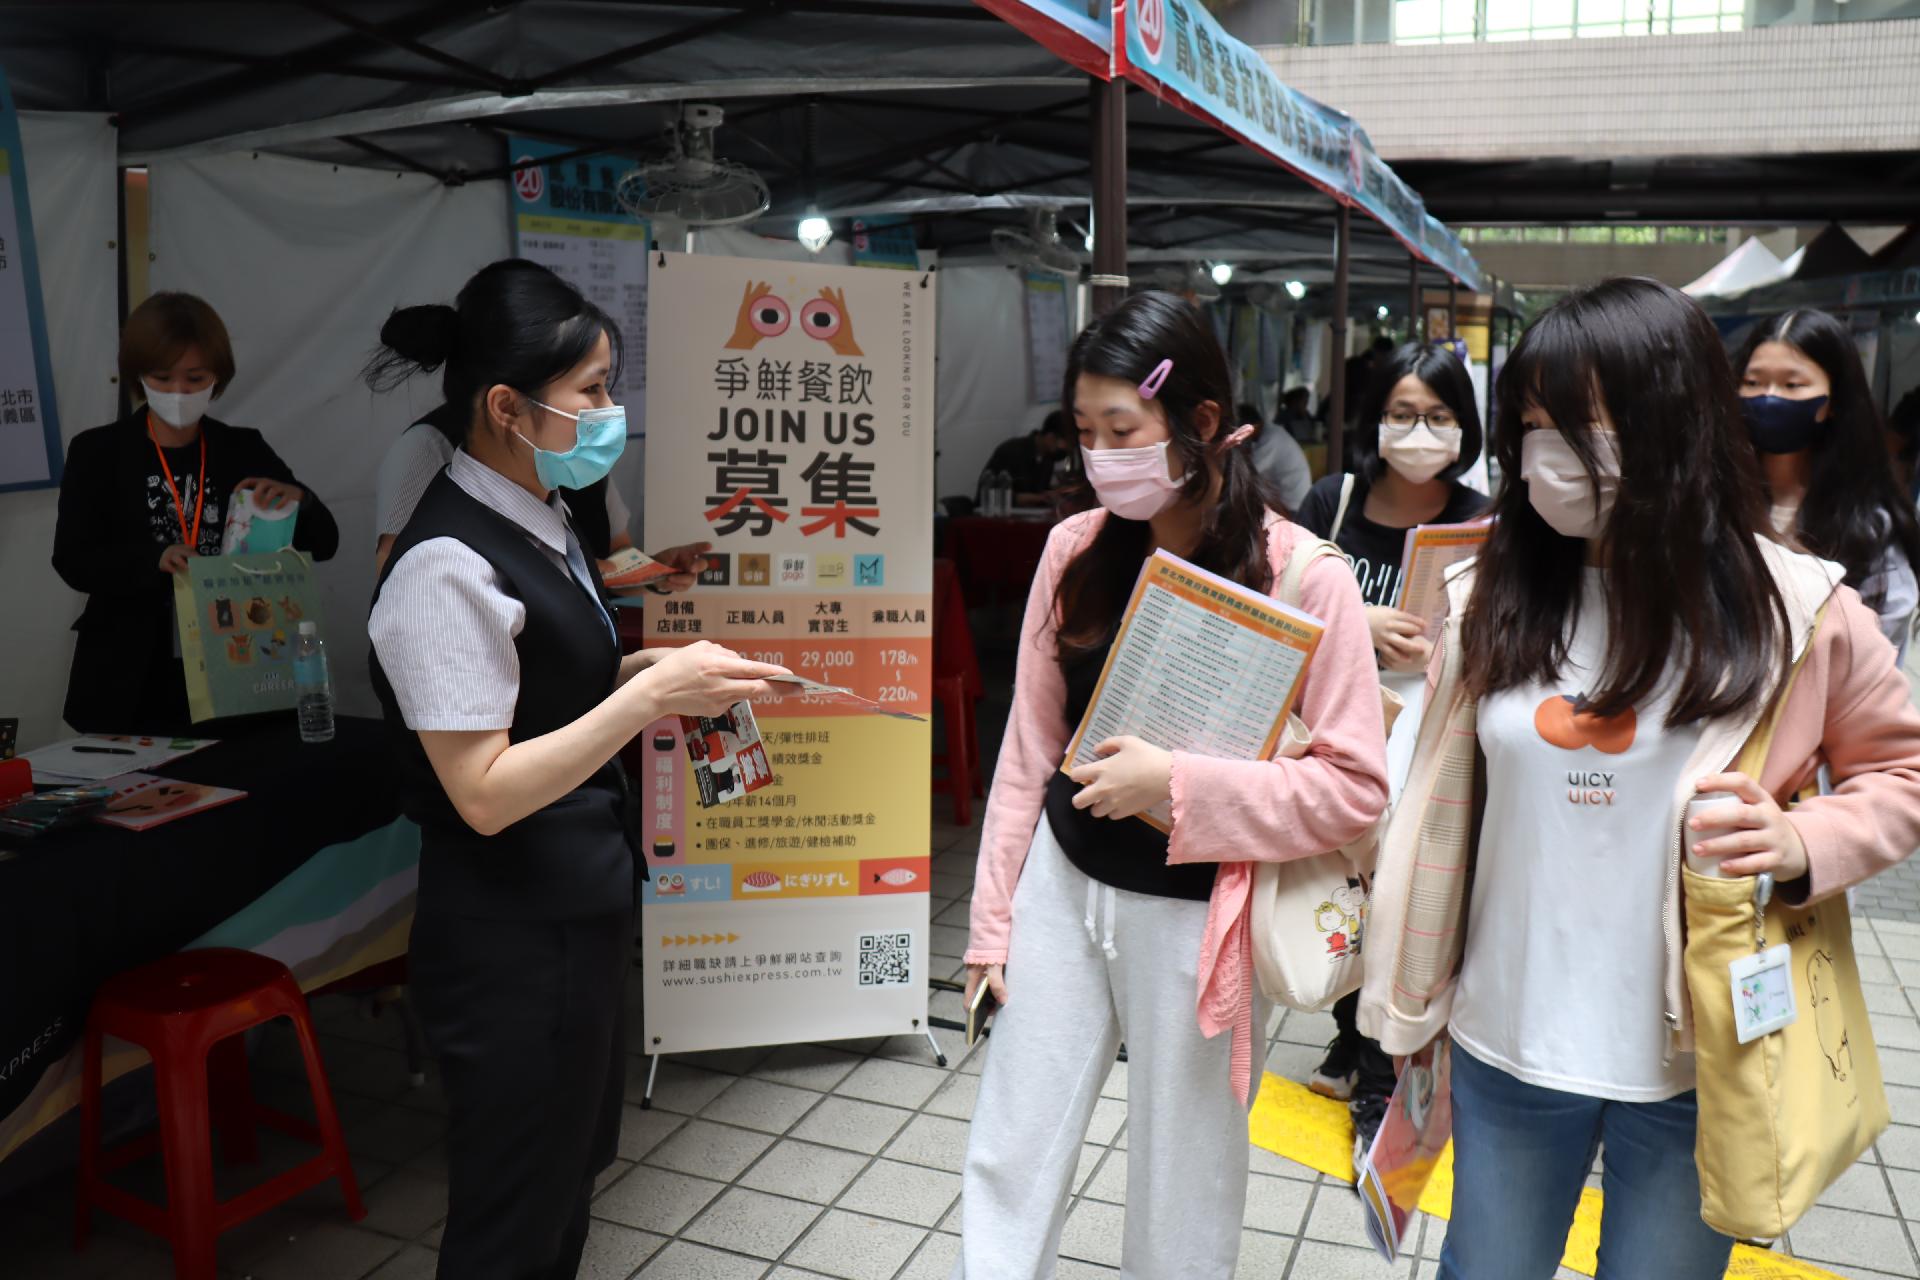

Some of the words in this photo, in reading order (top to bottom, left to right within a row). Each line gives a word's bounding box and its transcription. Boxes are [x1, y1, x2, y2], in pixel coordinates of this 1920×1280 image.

[902, 281, 912, 298] WE
[902, 303, 912, 326] ARE
[902, 330, 912, 382] LOOKING
[714, 356, 873, 405] 爭鮮餐飲
[902, 386, 912, 409] FOR
[707, 407, 806, 444] JOIN
[823, 411, 876, 446] US
[902, 414, 912, 437] YOU
[703, 448, 881, 539] 募集
[665, 601, 695, 615] 儲備
[815, 601, 843, 615] 大專
[872, 609, 926, 623] 兼職人員
[657, 619, 702, 633] 店經理
[726, 610, 785, 625] 正職人員
[808, 619, 849, 633] 實習生
[801, 650, 855, 669] 29,000
[1568, 771, 1615, 788] UICY
[1568, 789, 1615, 806] UICY
[785, 872, 849, 888] にぎりずし
[663, 951, 842, 972] 詳細職缺請上爭鮮網站查詢
[662, 966, 842, 987] www.sushiexpress.com.tw
